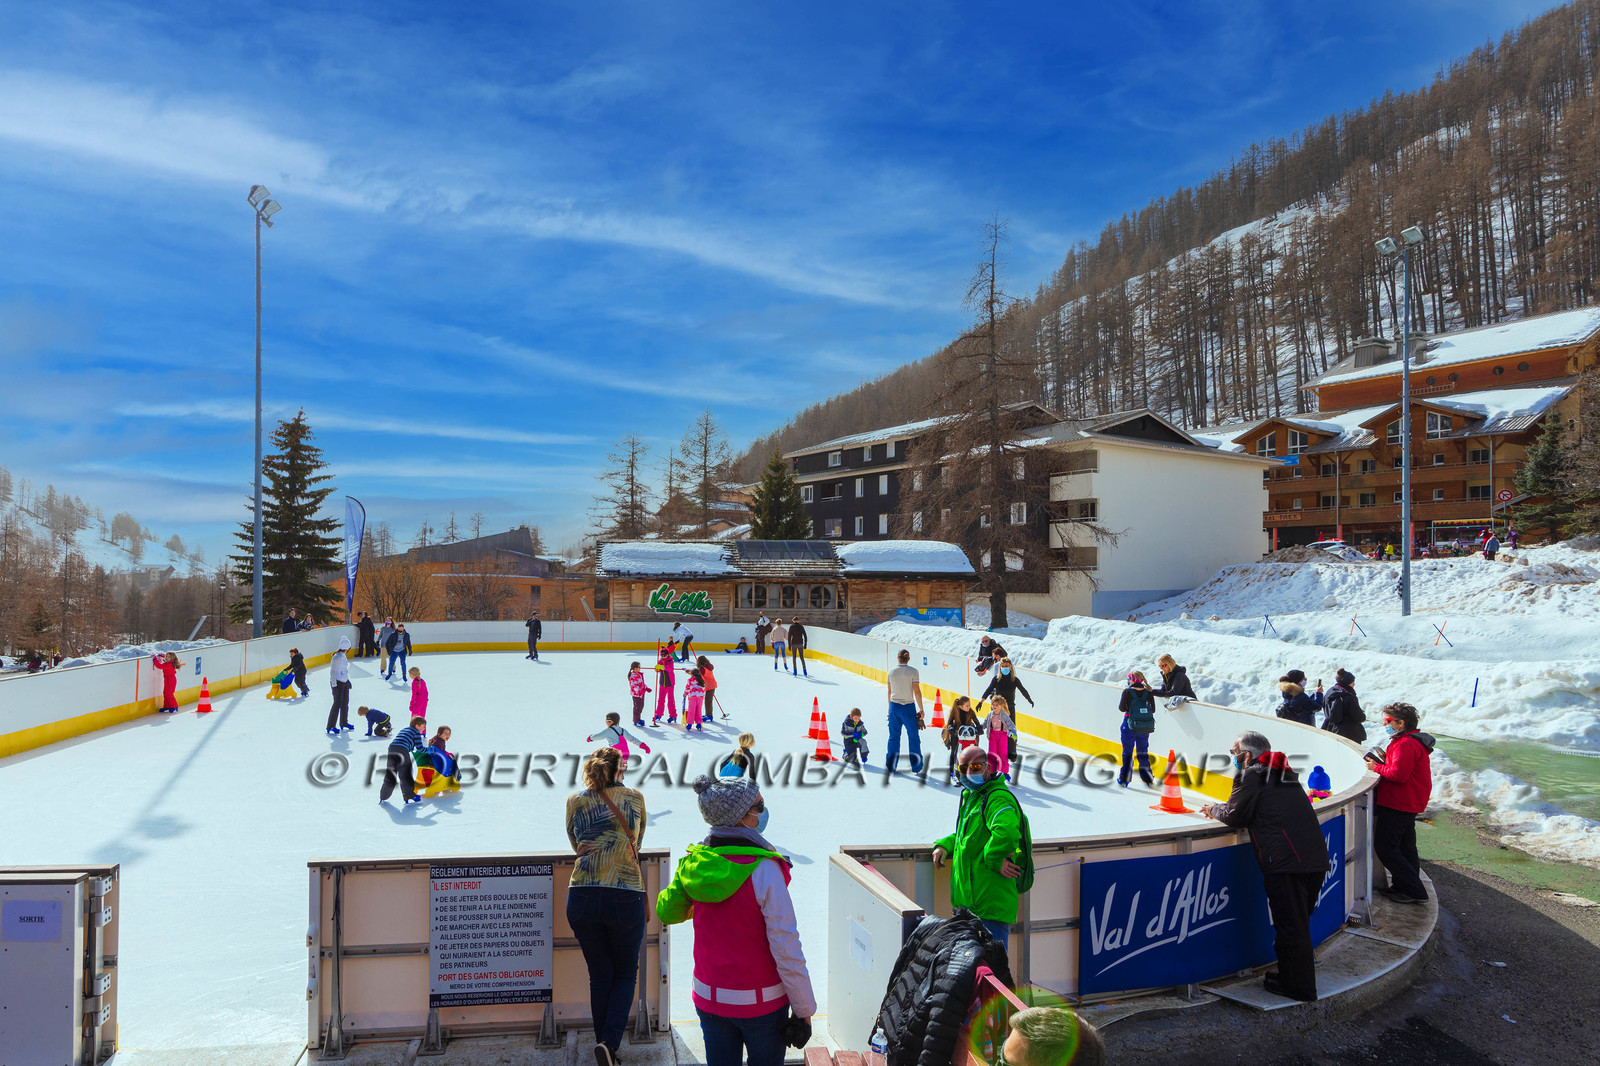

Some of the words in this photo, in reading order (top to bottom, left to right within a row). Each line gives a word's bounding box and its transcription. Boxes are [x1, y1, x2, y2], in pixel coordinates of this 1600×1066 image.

[650, 584, 674, 609] Val
[671, 591, 712, 615] d'Allos
[431, 868, 468, 877] REGLEMENT
[469, 867, 501, 875] INTERIEUR
[503, 867, 510, 875] DE
[512, 867, 520, 875] LA
[521, 866, 551, 874] PATINOIRE
[434, 883, 440, 891] IL
[441, 882, 452, 890] EST
[454, 881, 481, 890] INTERDIT
[1090, 882, 1140, 955] Val
[1146, 862, 1230, 944] d'Allos
[499, 970, 544, 978] OBLIGATOIRE
